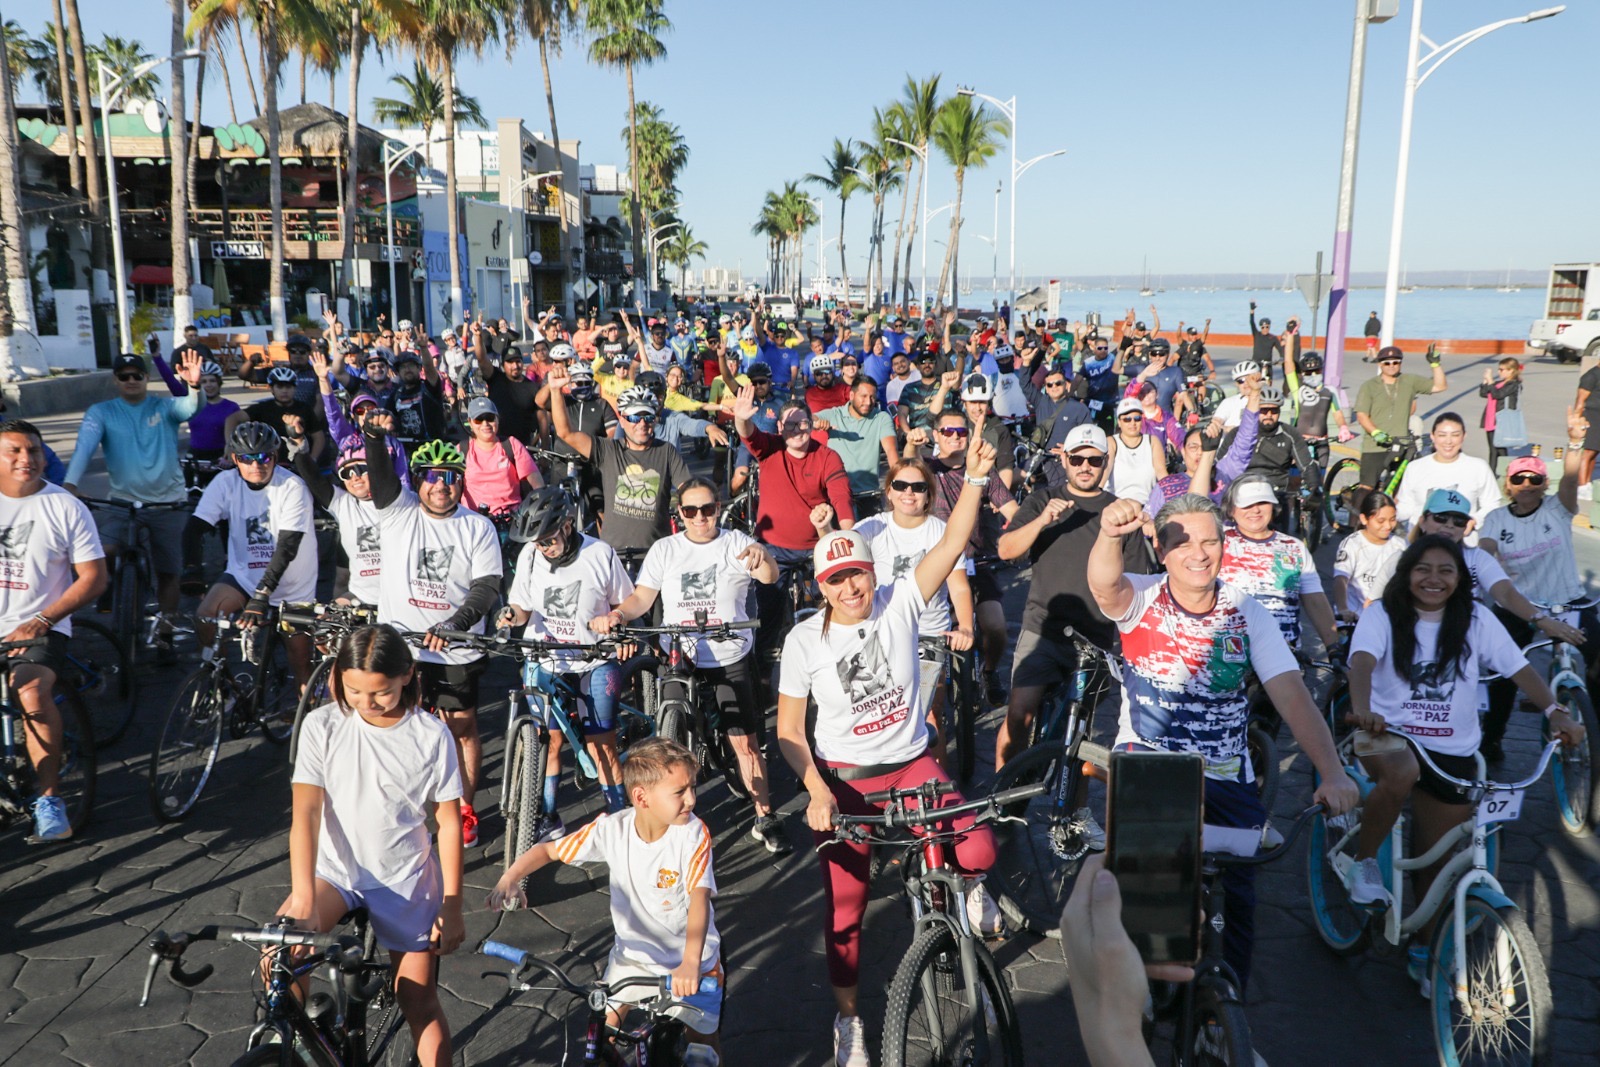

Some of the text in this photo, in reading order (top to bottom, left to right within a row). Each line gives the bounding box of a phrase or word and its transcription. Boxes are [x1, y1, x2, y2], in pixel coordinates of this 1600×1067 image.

[228, 244, 261, 256] MAJA
[428, 251, 465, 273] TOUS
[426, 590, 446, 599] PAZ
[677, 600, 716, 608] JORNADAS
[556, 626, 575, 636] PAZ
[851, 685, 905, 715] JORNADAS
[879, 694, 906, 716] PAZ
[1401, 702, 1451, 711] JORNADAS
[893, 710, 908, 721] BCS
[1425, 711, 1450, 722] PAZ
[1487, 800, 1509, 814] 07
